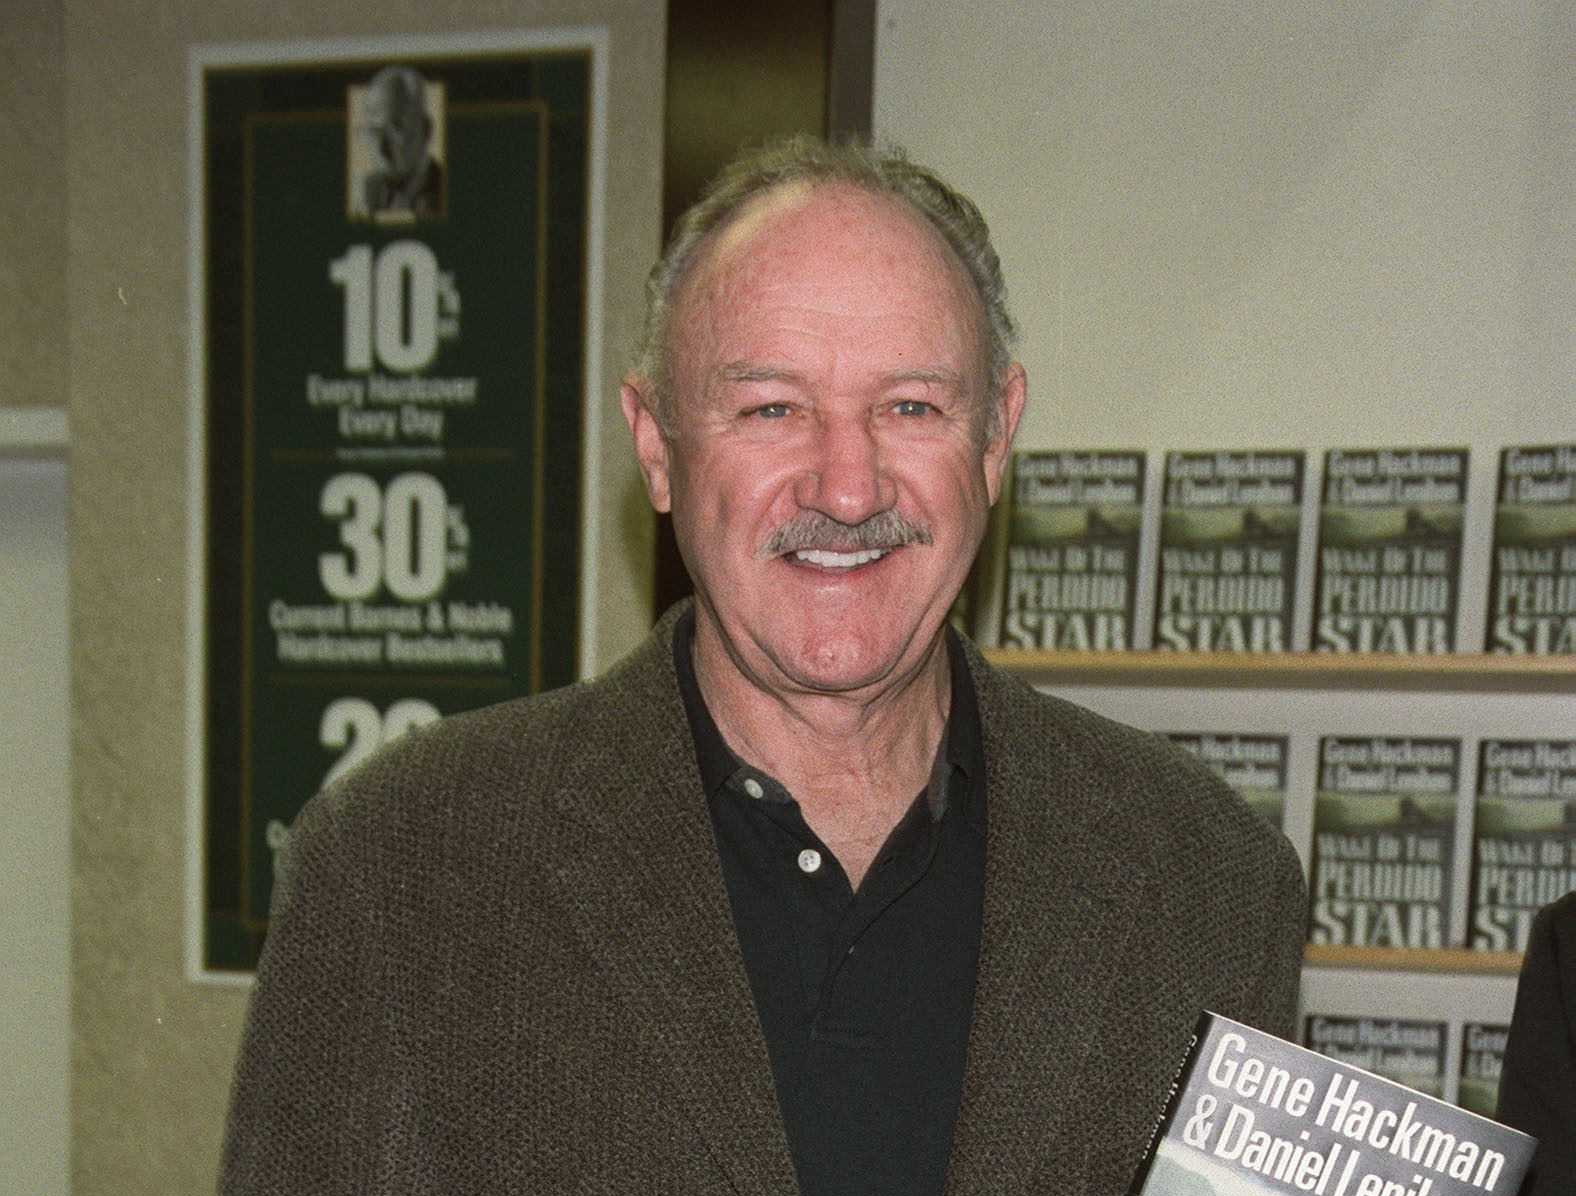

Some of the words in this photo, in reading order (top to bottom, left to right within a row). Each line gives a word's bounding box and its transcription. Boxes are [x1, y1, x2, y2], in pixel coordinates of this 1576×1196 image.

[1006, 613, 1126, 650] STAR
[1159, 614, 1283, 651] STAR
[1318, 617, 1447, 652] STAR
[1494, 620, 1576, 652] STA
[1312, 902, 1440, 947] STAR
[1207, 1032, 1316, 1117] Gene
[1315, 1072, 1506, 1191] Hackman
[1182, 1094, 1218, 1150] &
[1214, 1104, 1342, 1196] Daniel
